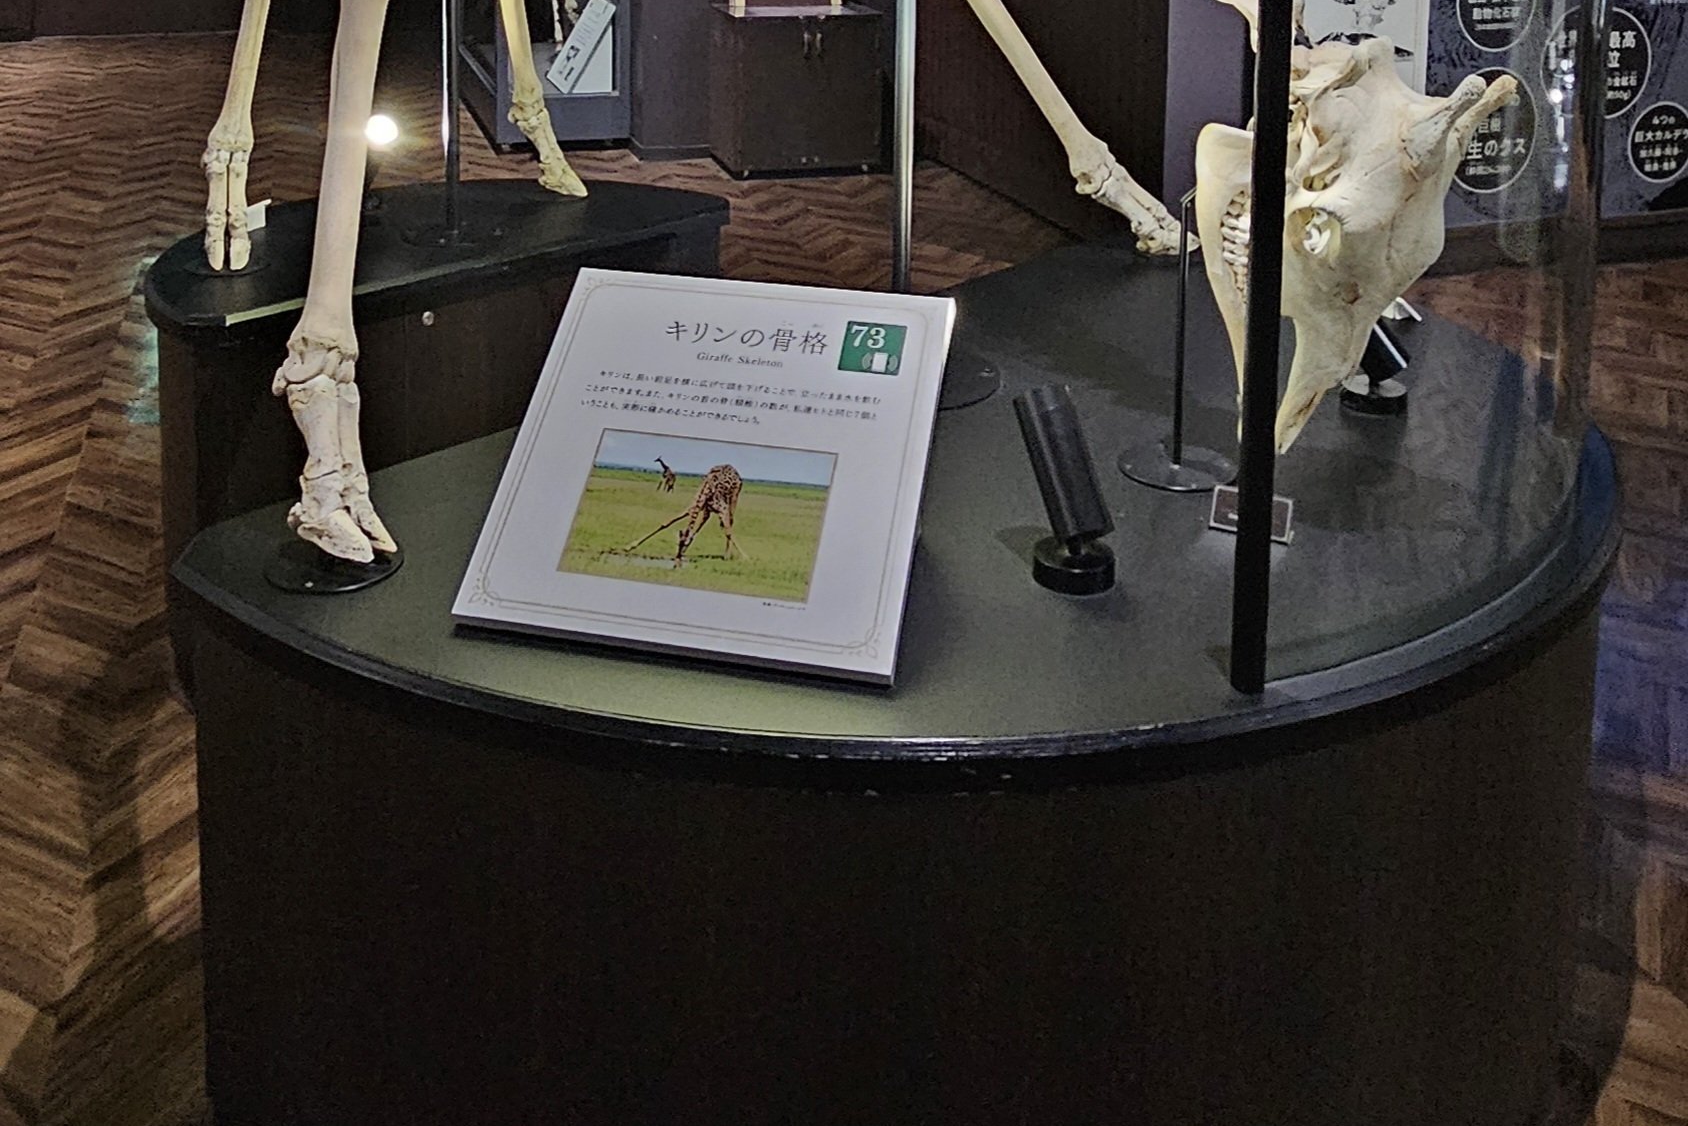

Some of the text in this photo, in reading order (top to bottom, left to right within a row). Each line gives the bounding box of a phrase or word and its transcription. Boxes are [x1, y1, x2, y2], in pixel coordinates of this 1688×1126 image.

[665, 321, 829, 356] キリンの骨格
[851, 325, 886, 349] 73
[696, 352, 784, 368] Giraffe Skeleton
